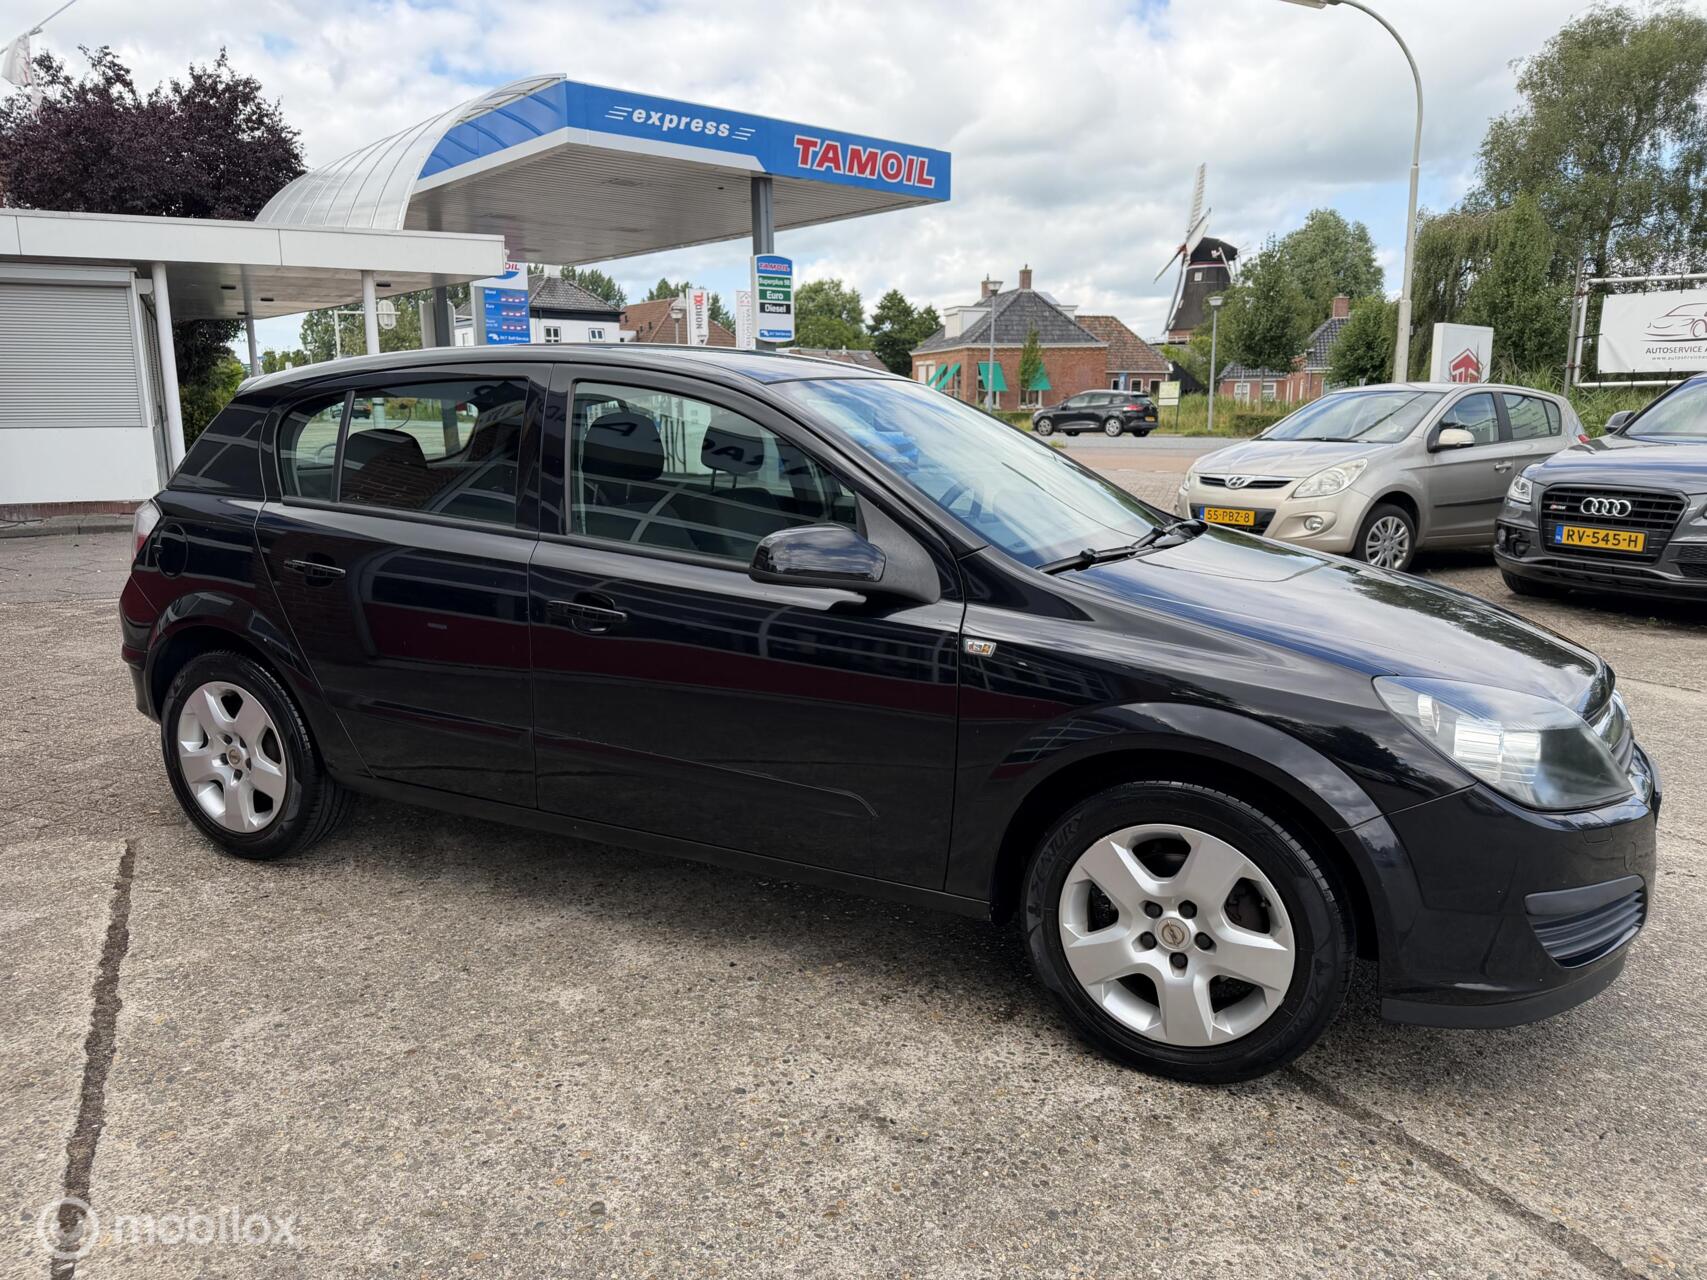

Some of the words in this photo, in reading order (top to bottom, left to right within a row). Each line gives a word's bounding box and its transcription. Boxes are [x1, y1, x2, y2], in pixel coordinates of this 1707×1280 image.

[632, 107, 730, 137] express
[794, 135, 935, 188] TAMOIL
[766, 291, 784, 300] Euro
[764, 304, 787, 313] Diesel
[1645, 346, 1703, 354] AUTOSERVICE
[1207, 509, 1250, 522] 55-PBZ-8
[1566, 528, 1639, 549] RV-545-H
